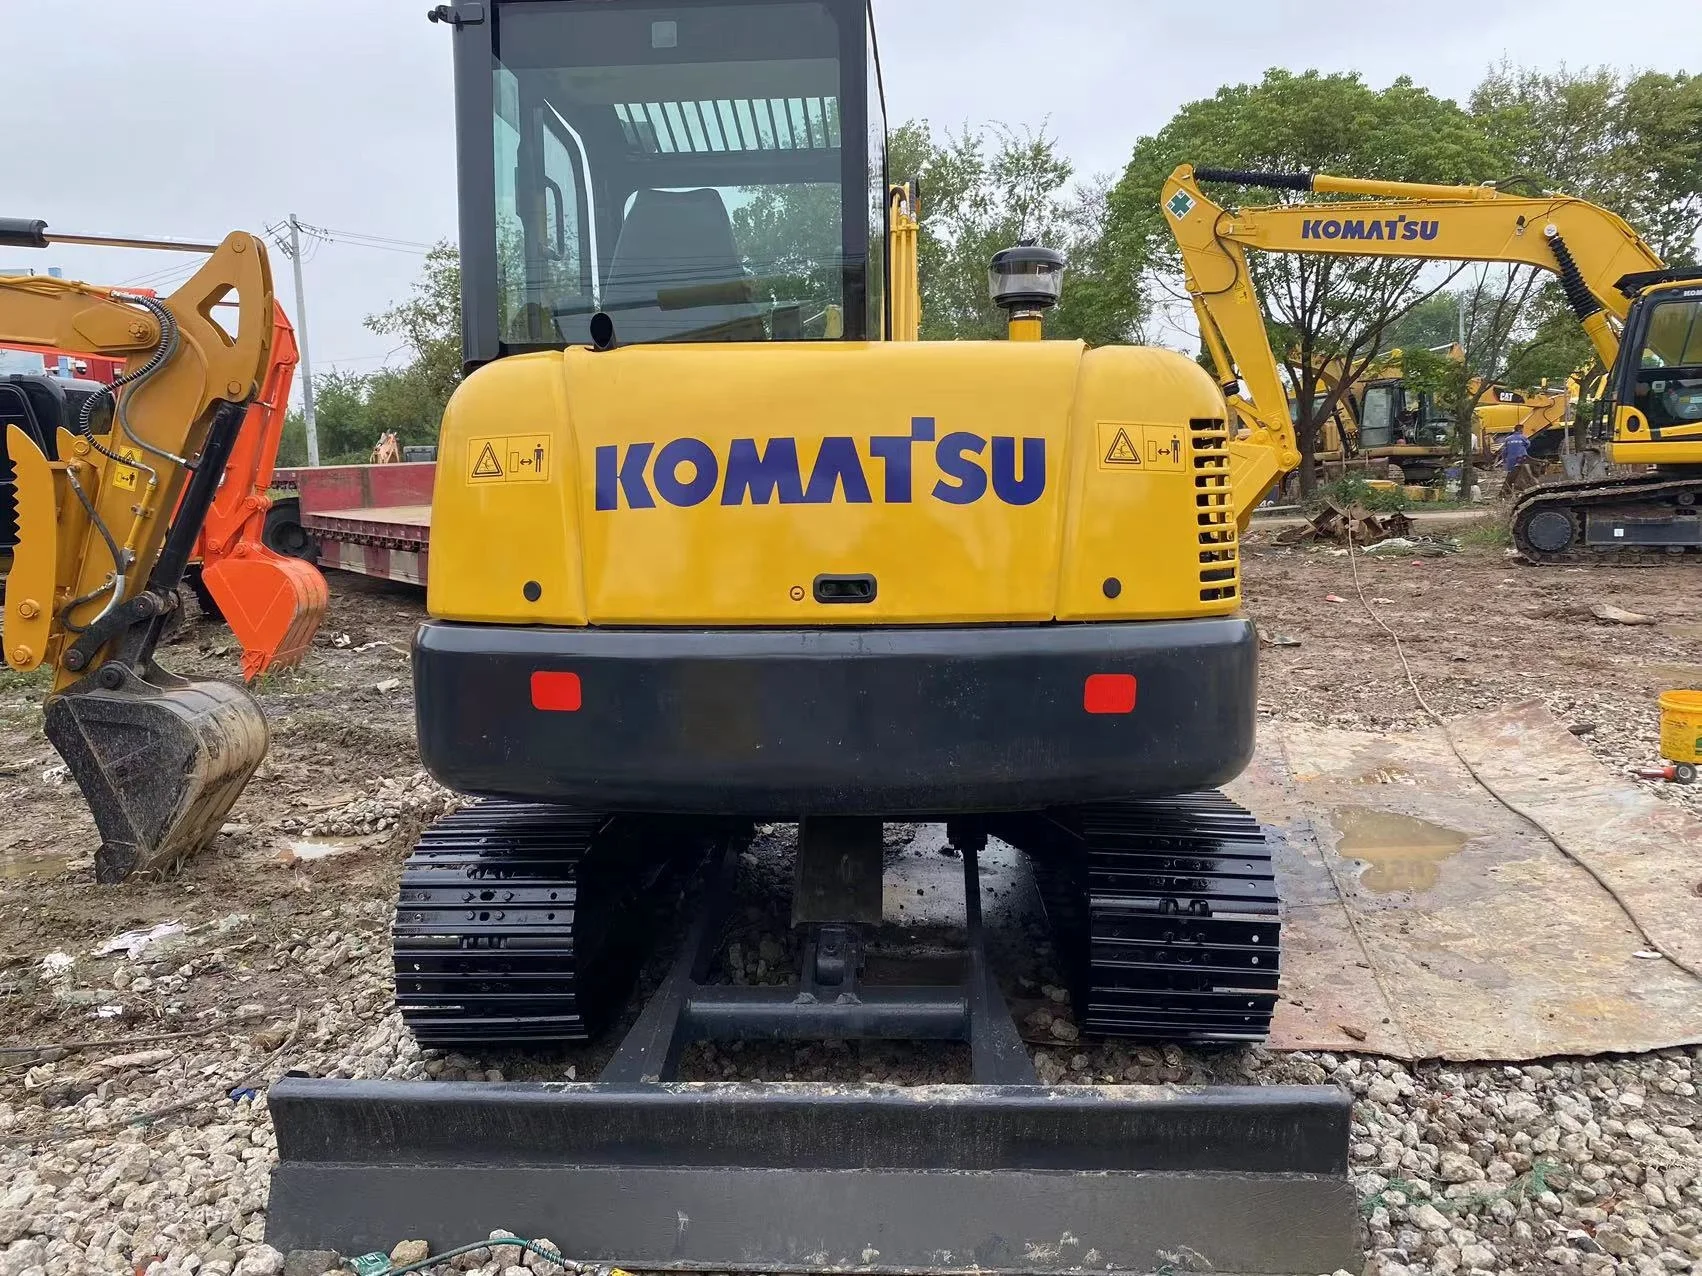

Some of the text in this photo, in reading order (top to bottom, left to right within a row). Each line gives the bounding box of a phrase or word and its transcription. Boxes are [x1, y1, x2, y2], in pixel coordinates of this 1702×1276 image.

[1301, 214, 1439, 241] KOMATSU
[1500, 391, 1514, 402] CAT
[595, 416, 1046, 511] KOMATSU
